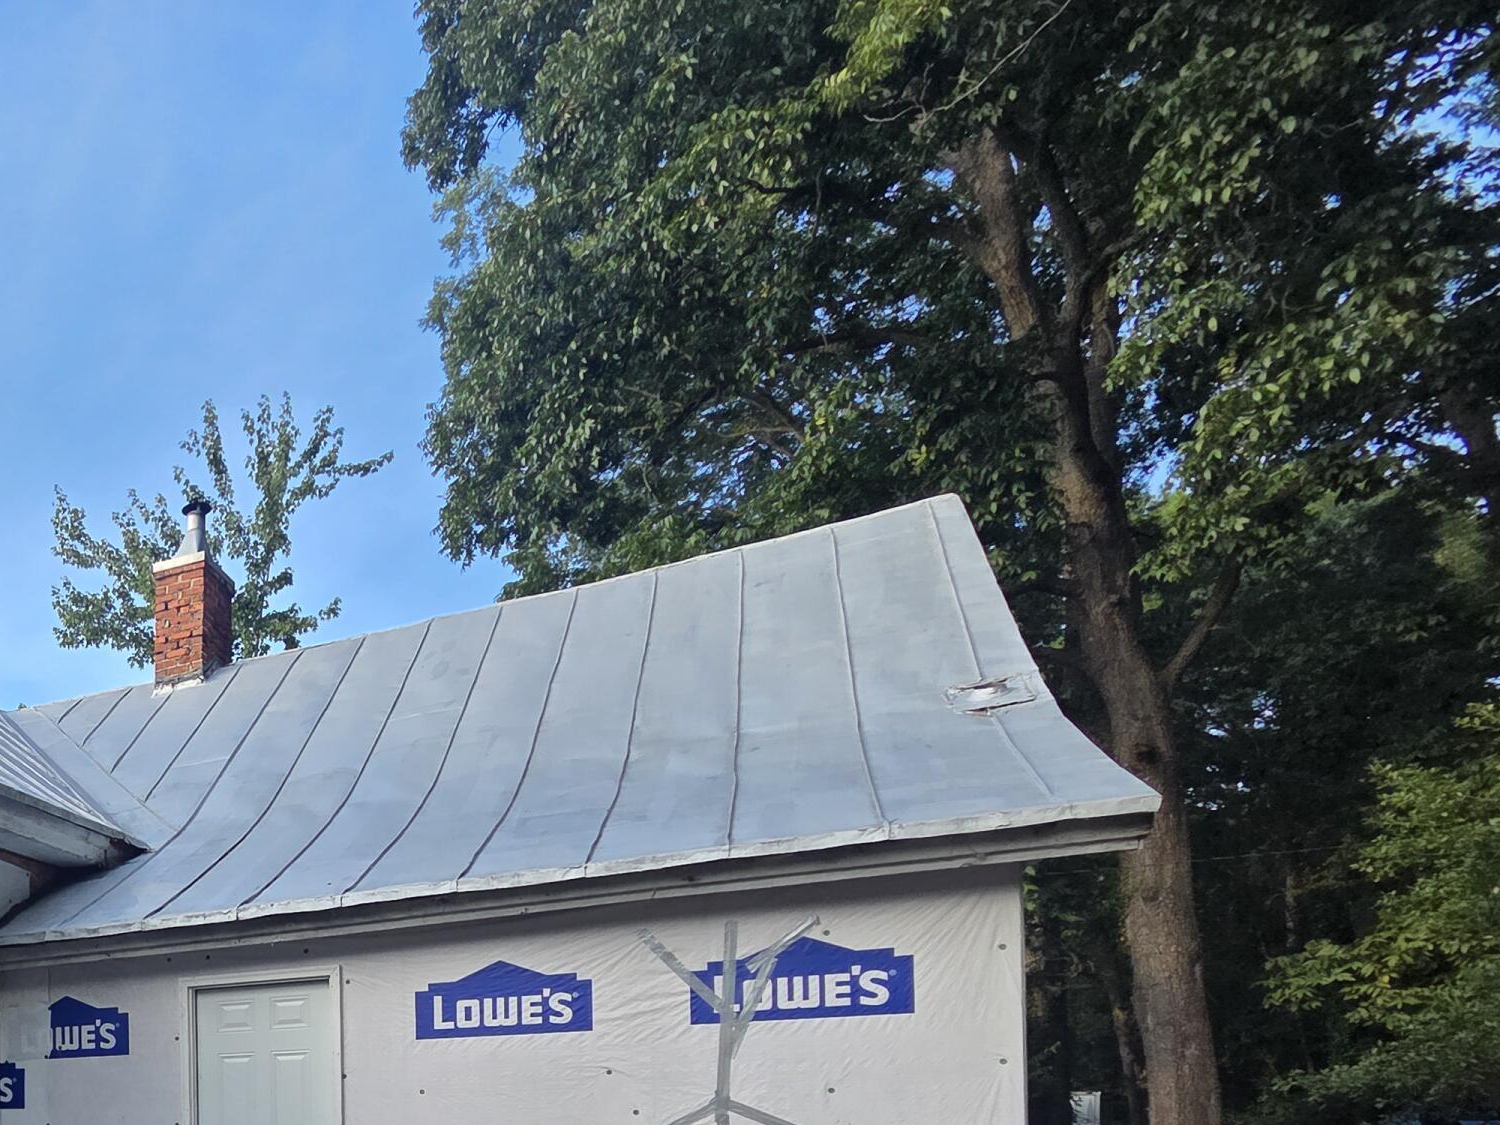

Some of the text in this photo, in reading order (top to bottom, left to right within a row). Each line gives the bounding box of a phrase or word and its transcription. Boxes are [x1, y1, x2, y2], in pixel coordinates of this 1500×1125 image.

[434, 988, 573, 1030] LOWE'S
[713, 965, 890, 1014] LOWE'S
[50, 1019, 117, 1051] WE'S
